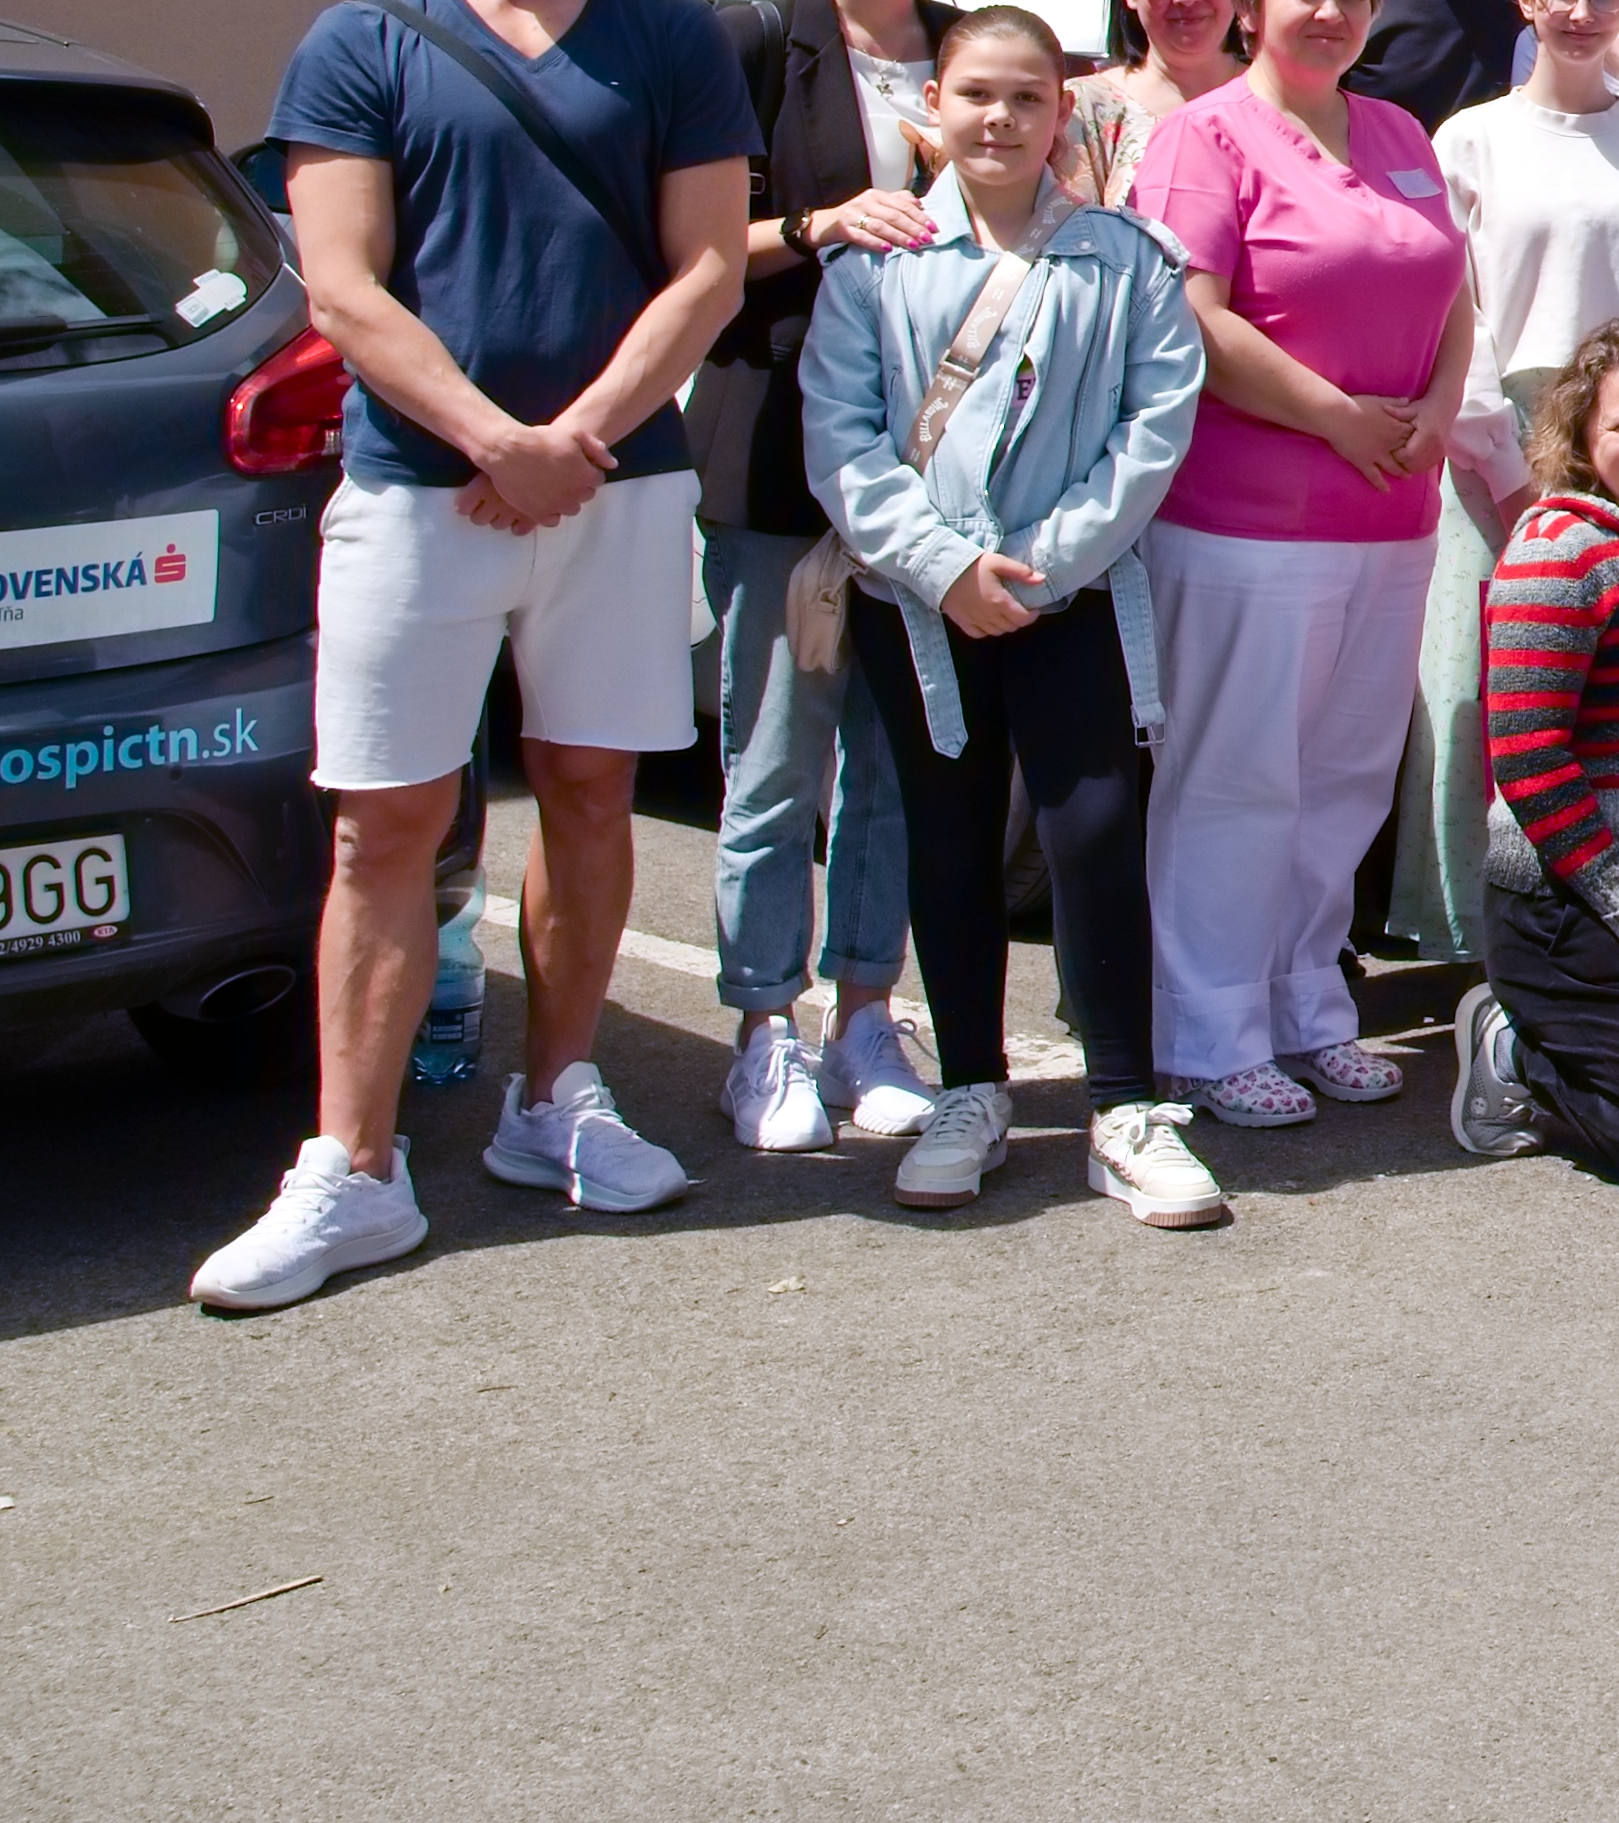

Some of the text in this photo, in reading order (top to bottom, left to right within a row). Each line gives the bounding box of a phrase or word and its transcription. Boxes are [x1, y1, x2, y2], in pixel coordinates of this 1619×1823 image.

[1016, 378, 1036, 401] E
[0, 707, 259, 790] ospictn.sk
[48, 929, 81, 946] 4300
